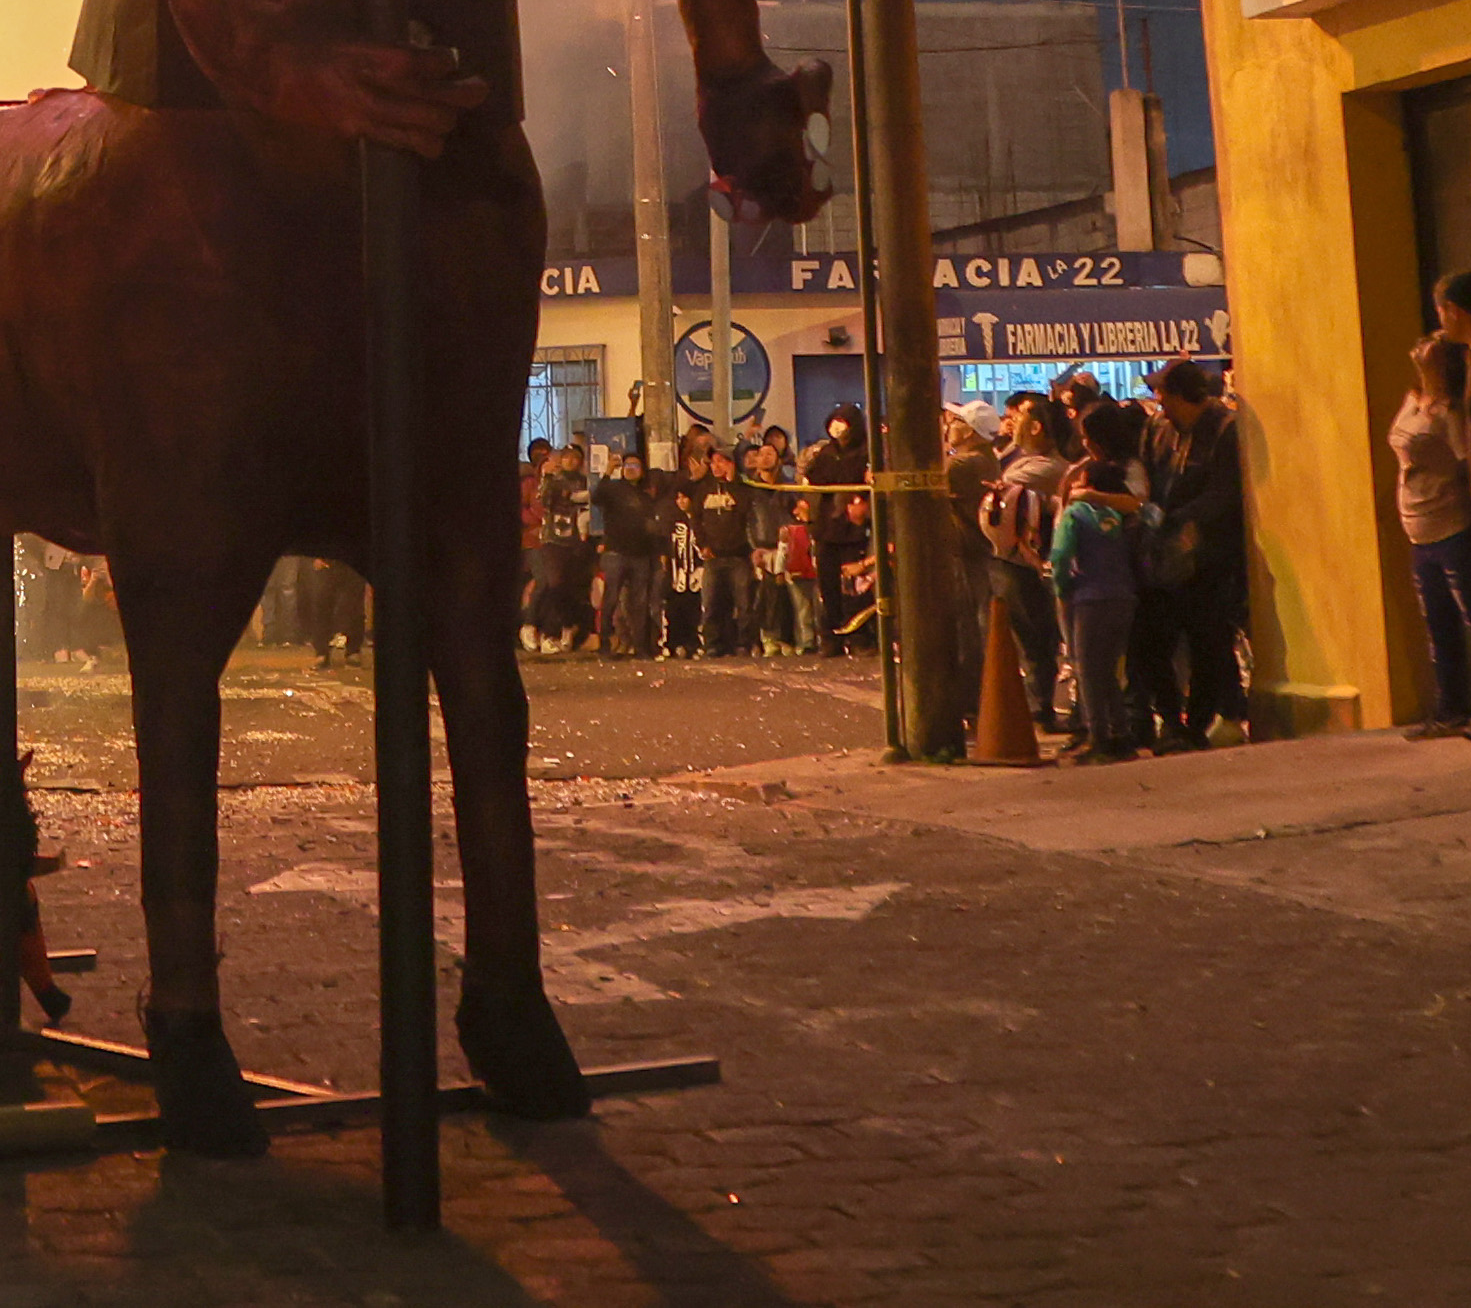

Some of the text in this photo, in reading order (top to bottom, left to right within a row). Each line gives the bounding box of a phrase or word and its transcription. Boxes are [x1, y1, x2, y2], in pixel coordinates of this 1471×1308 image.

[540, 265, 601, 295] CIA
[792, 257, 1124, 290] FAACIA LA 22
[1006, 320, 1201, 355] FARMACIA Y LIBRERIA LA 22
[685, 346, 747, 370] Vapub
